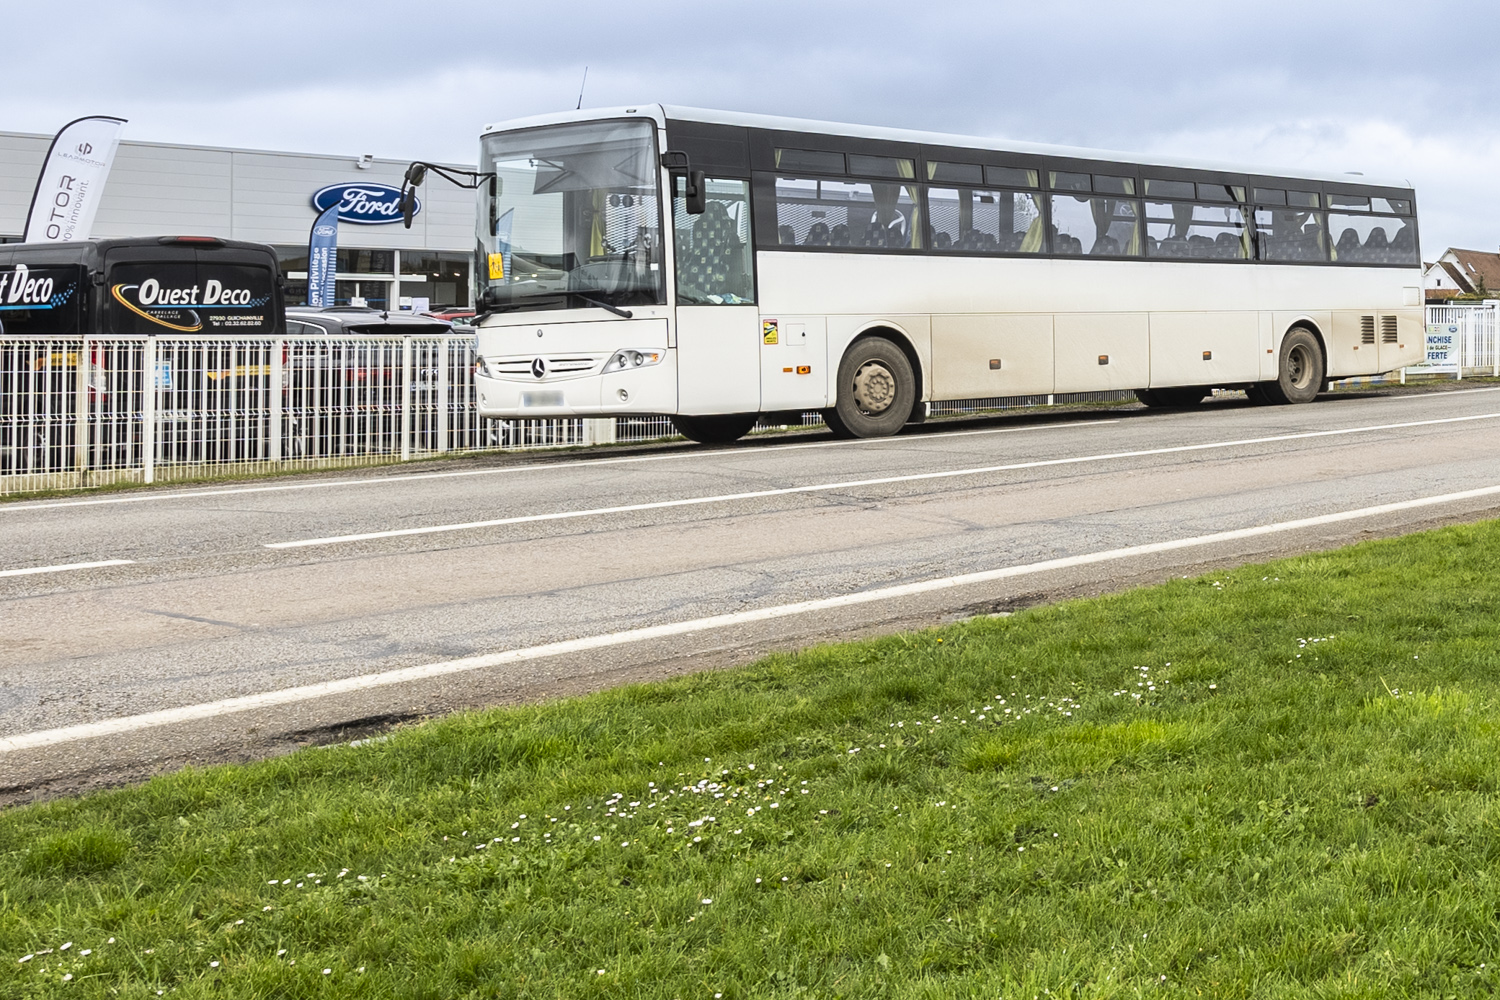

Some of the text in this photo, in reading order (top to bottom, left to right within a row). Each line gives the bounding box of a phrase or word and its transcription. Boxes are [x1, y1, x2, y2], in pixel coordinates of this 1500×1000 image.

[338, 188, 400, 215] Ford
[7, 264, 54, 304] Deco
[138, 278, 251, 305] Ouest Deco
